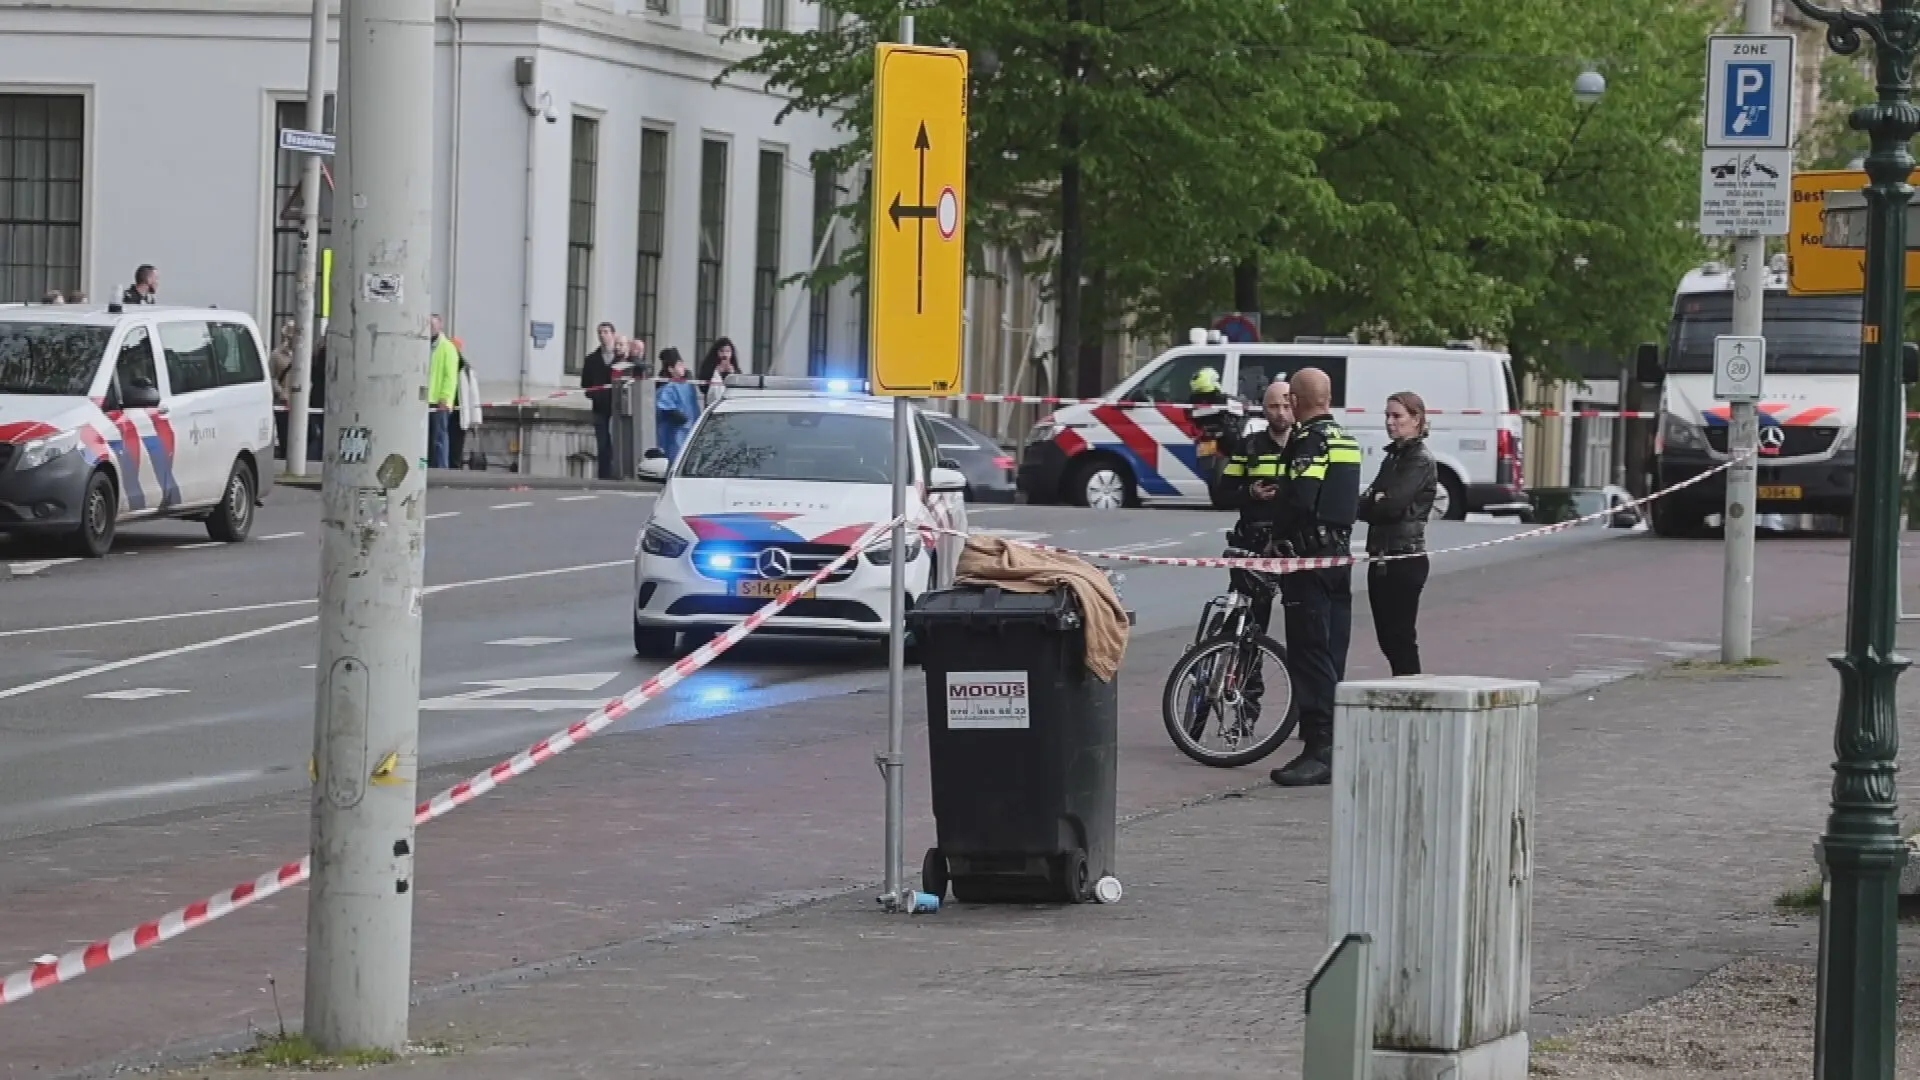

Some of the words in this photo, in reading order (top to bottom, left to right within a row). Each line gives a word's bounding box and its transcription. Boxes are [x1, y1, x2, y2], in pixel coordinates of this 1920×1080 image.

[1733, 43, 1768, 55] ZONE
[1736, 68, 1764, 106] P
[1793, 189, 1825, 203] Best
[1730, 363, 1746, 375] 28
[732, 500, 829, 510] POLITIE
[742, 581, 795, 595] S-146-
[949, 685, 1025, 697] MODUS
